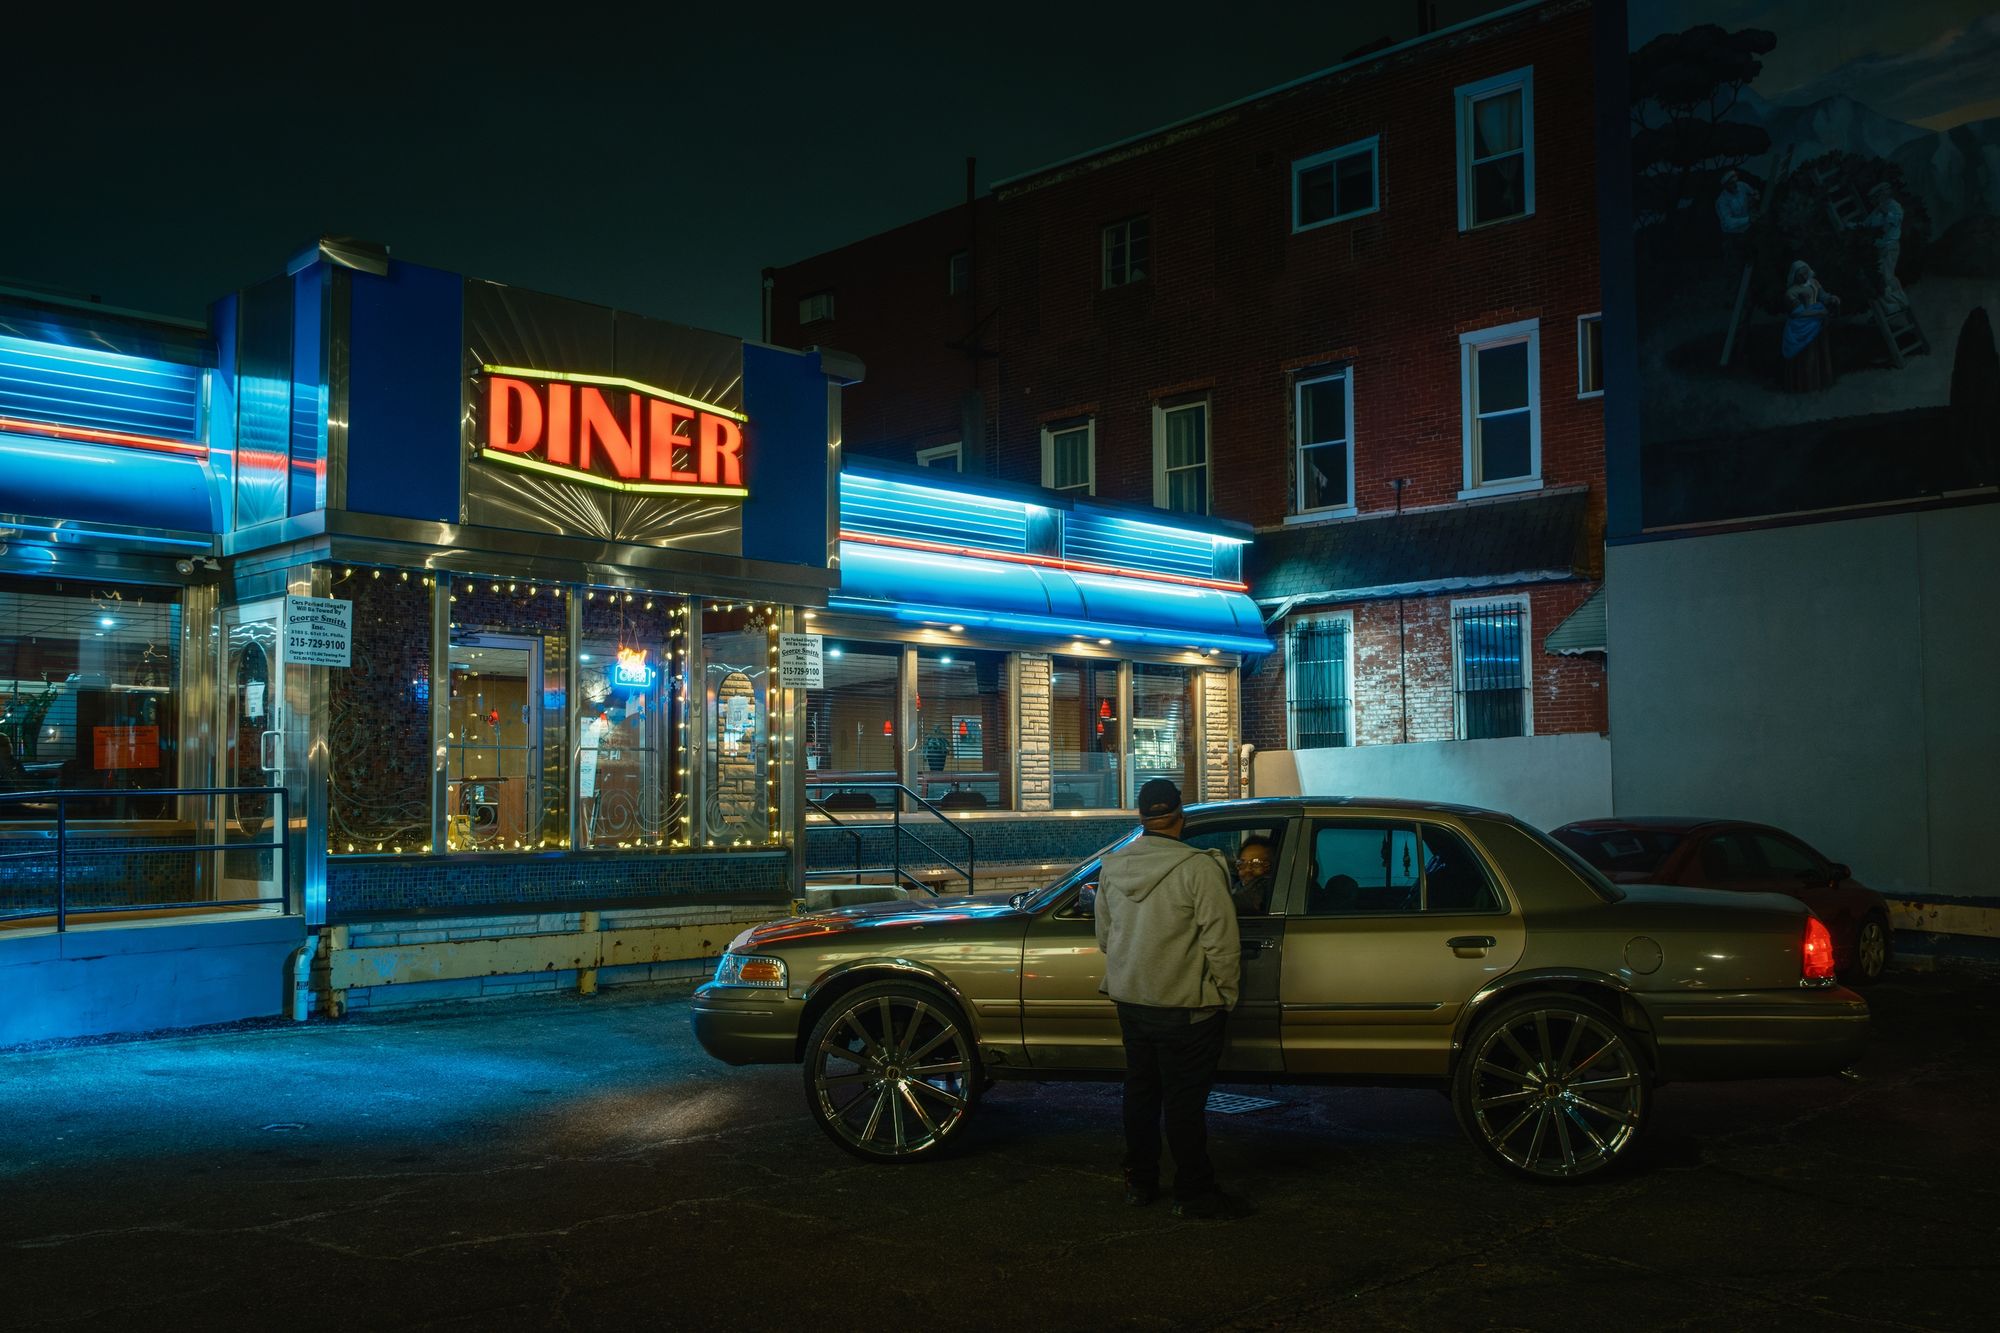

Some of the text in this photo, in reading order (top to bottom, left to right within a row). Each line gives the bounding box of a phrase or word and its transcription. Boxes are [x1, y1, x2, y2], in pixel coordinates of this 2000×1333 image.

[489, 377, 743, 485] DINER
[320, 614, 346, 628] Smith
[290, 637, 346, 650] 215-729-9100
[801, 648, 820, 658] Smith
[620, 669, 647, 683] OPEN
[782, 666, 820, 676] 215-729-9100
